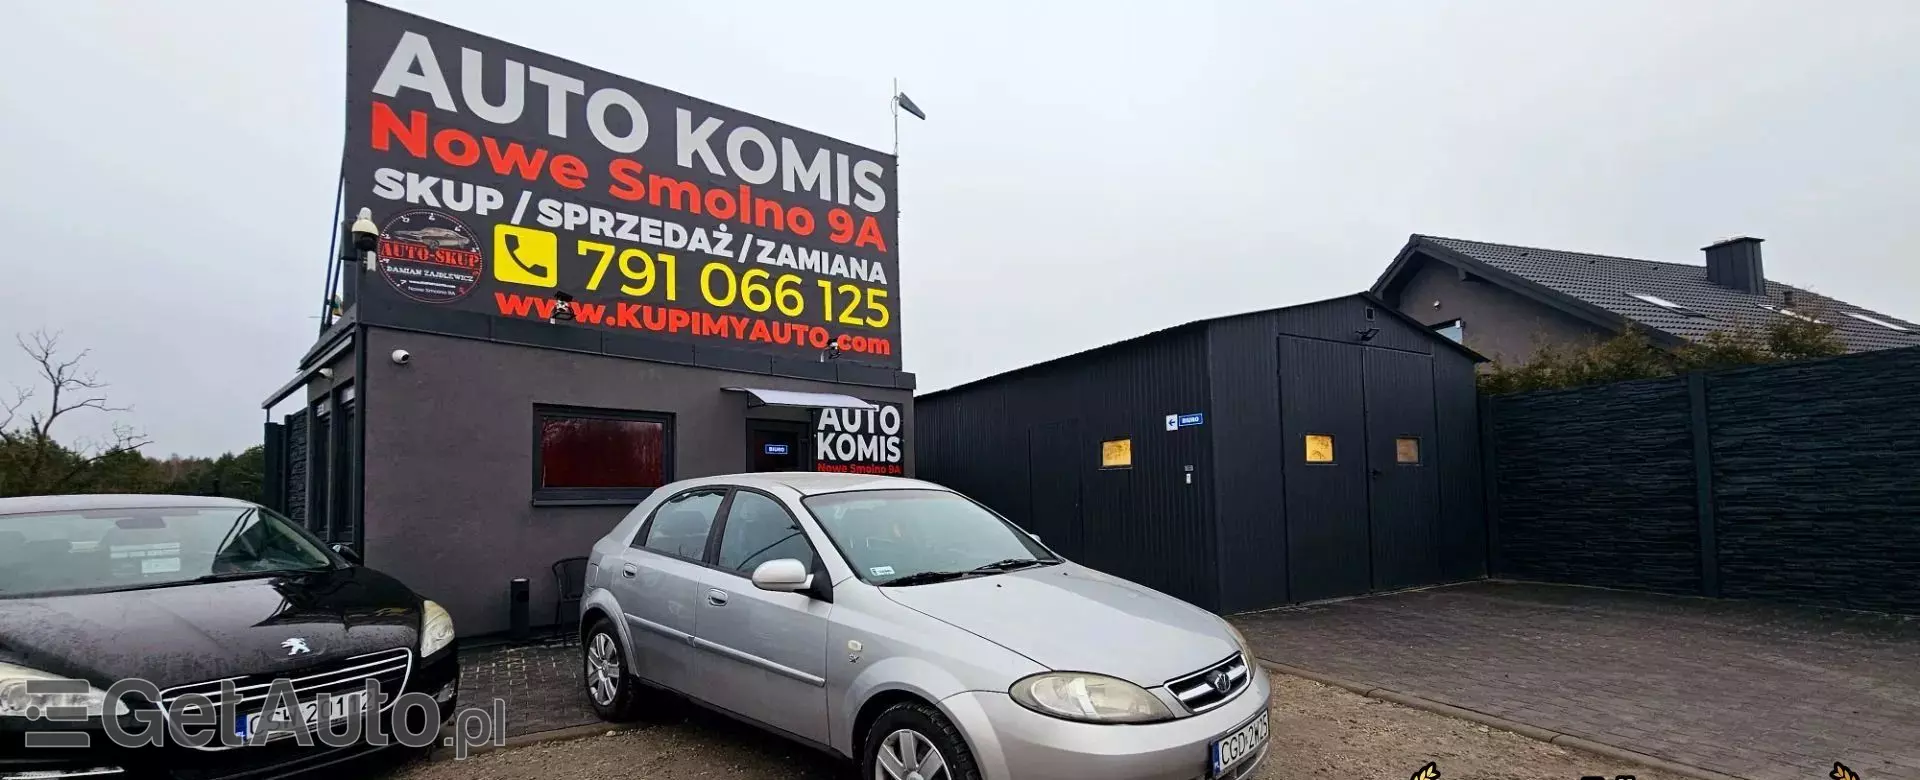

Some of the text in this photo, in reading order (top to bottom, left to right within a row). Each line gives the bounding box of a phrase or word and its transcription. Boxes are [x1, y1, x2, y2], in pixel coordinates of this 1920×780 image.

[371, 30, 886, 213] AUTO KOMIS
[371, 100, 887, 252] Nowe Smolno 9A
[372, 167, 504, 216] SKUP
[536, 198, 734, 258] SPRZEDAŻ
[756, 239, 888, 285] ZAMIANA
[381, 243, 479, 267] AUTO-SKUP
[386, 266, 422, 276] DAMIAN
[577, 239, 890, 328] 791 066 125
[817, 404, 900, 435] AUTO
[817, 432, 901, 463] KOMIS
[817, 463, 848, 473] Nowe
[1221, 732, 1245, 765] CGD
